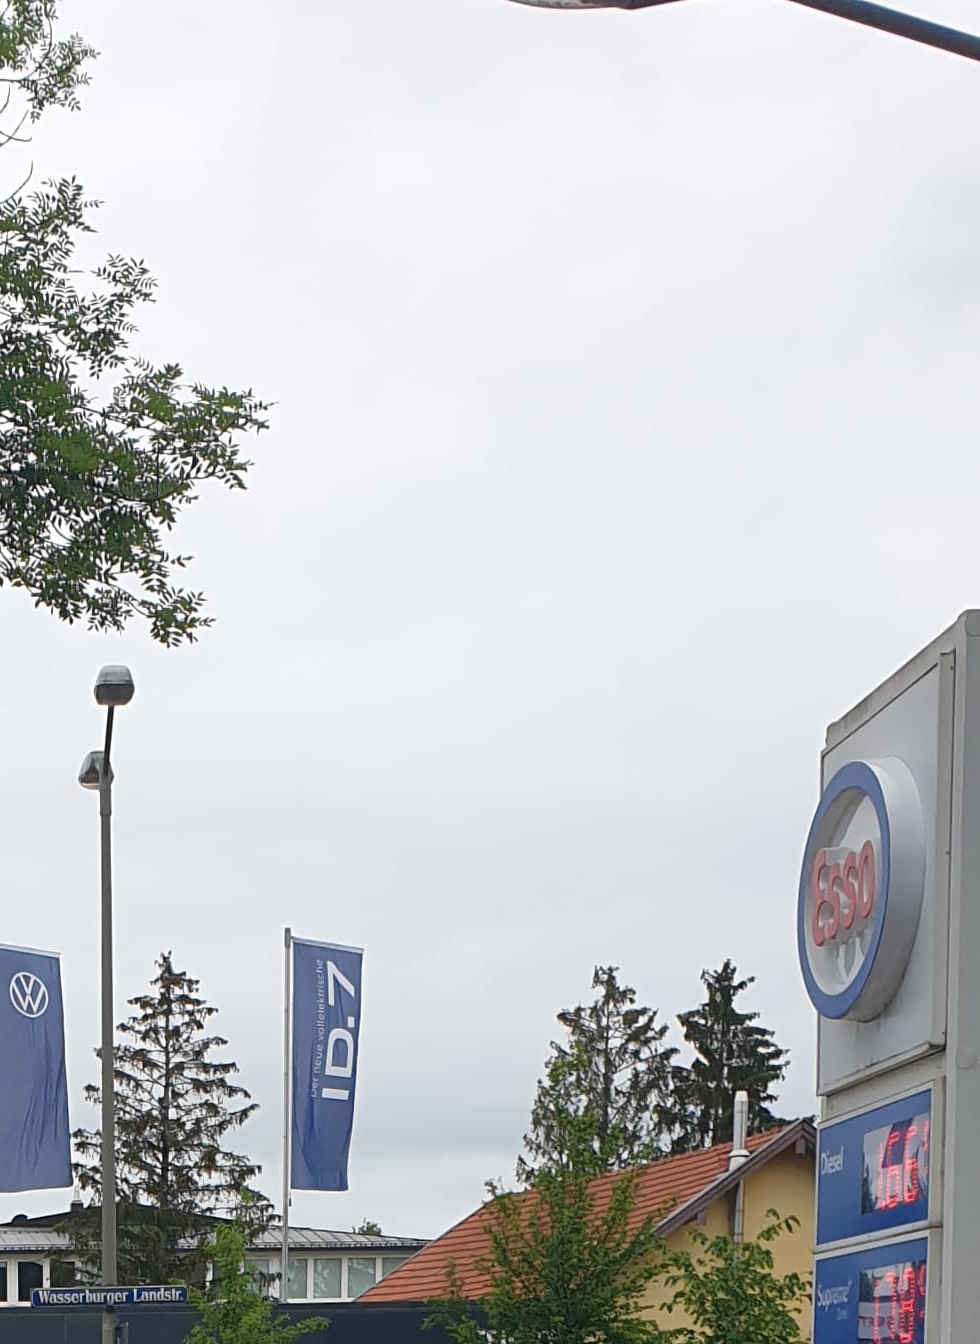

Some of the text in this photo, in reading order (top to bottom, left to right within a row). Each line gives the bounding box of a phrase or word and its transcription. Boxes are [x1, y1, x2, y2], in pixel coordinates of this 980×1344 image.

[821, 1146, 845, 1175] Diesel
[38, 1287, 184, 1305] Wasserburger Landstr.
